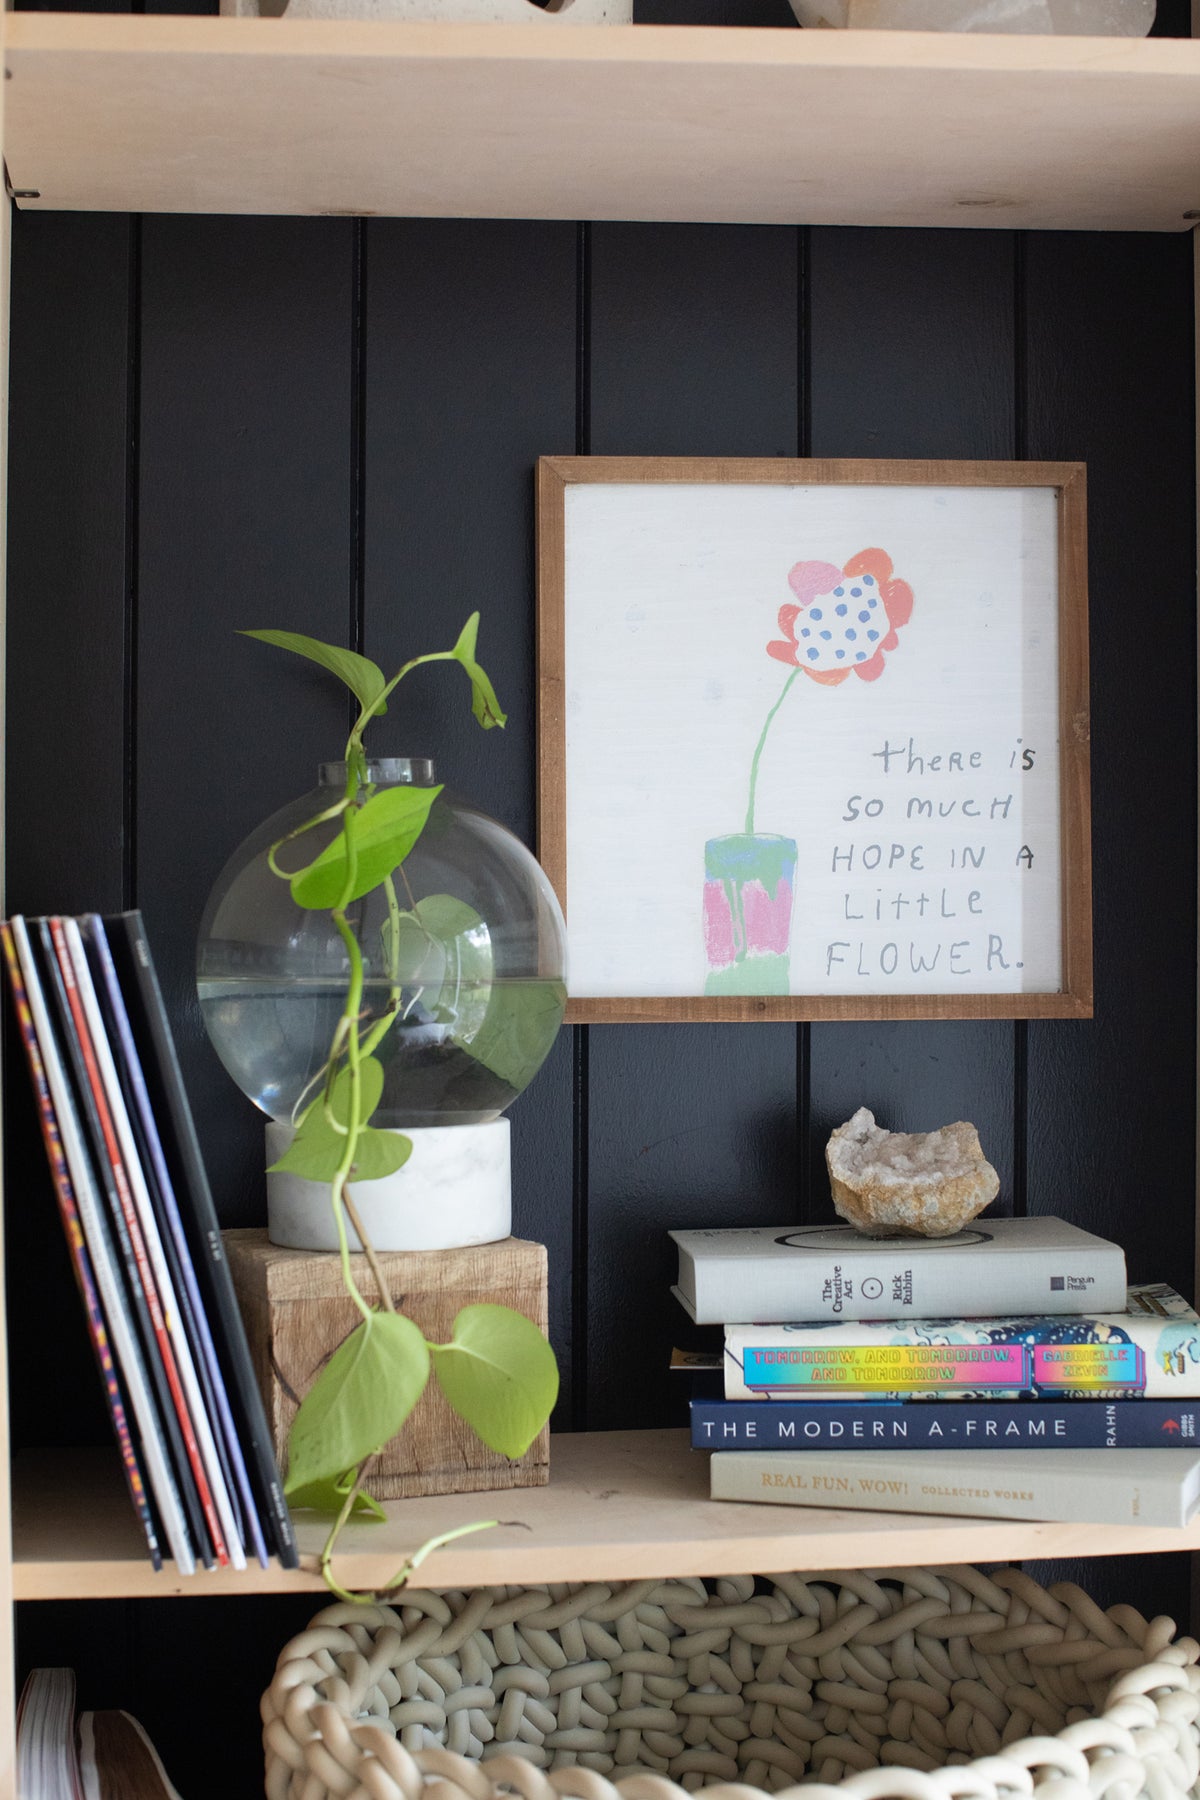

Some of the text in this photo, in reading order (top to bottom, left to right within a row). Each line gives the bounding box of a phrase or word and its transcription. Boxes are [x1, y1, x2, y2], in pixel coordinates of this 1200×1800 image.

[1009, 737, 1036, 771] is
[832, 843, 1035, 873] HOPE IN A
[827, 934, 1025, 976] FLOWER.
[822, 1279, 832, 1302] The
[832, 1265, 843, 1313] Creative
[843, 1280, 853, 1300] Act
[892, 1274, 902, 1301] Rick
[902, 1269, 913, 1305] Rubin
[1066, 1275, 1095, 1285] Penguin
[864, 1350, 901, 1364] AND
[1042, 1349, 1129, 1363] GABRIELLE
[810, 1366, 956, 1381] AND TOMORROW
[1063, 1364, 1109, 1378] ZEVIN
[703, 1418, 1067, 1438] THE MODERN A-FRAME
[1105, 1405, 1117, 1447] RAHN
[761, 1472, 909, 1496] REAL FUN, WOW!
[921, 1485, 1035, 1501] COLLECTED WORKS
